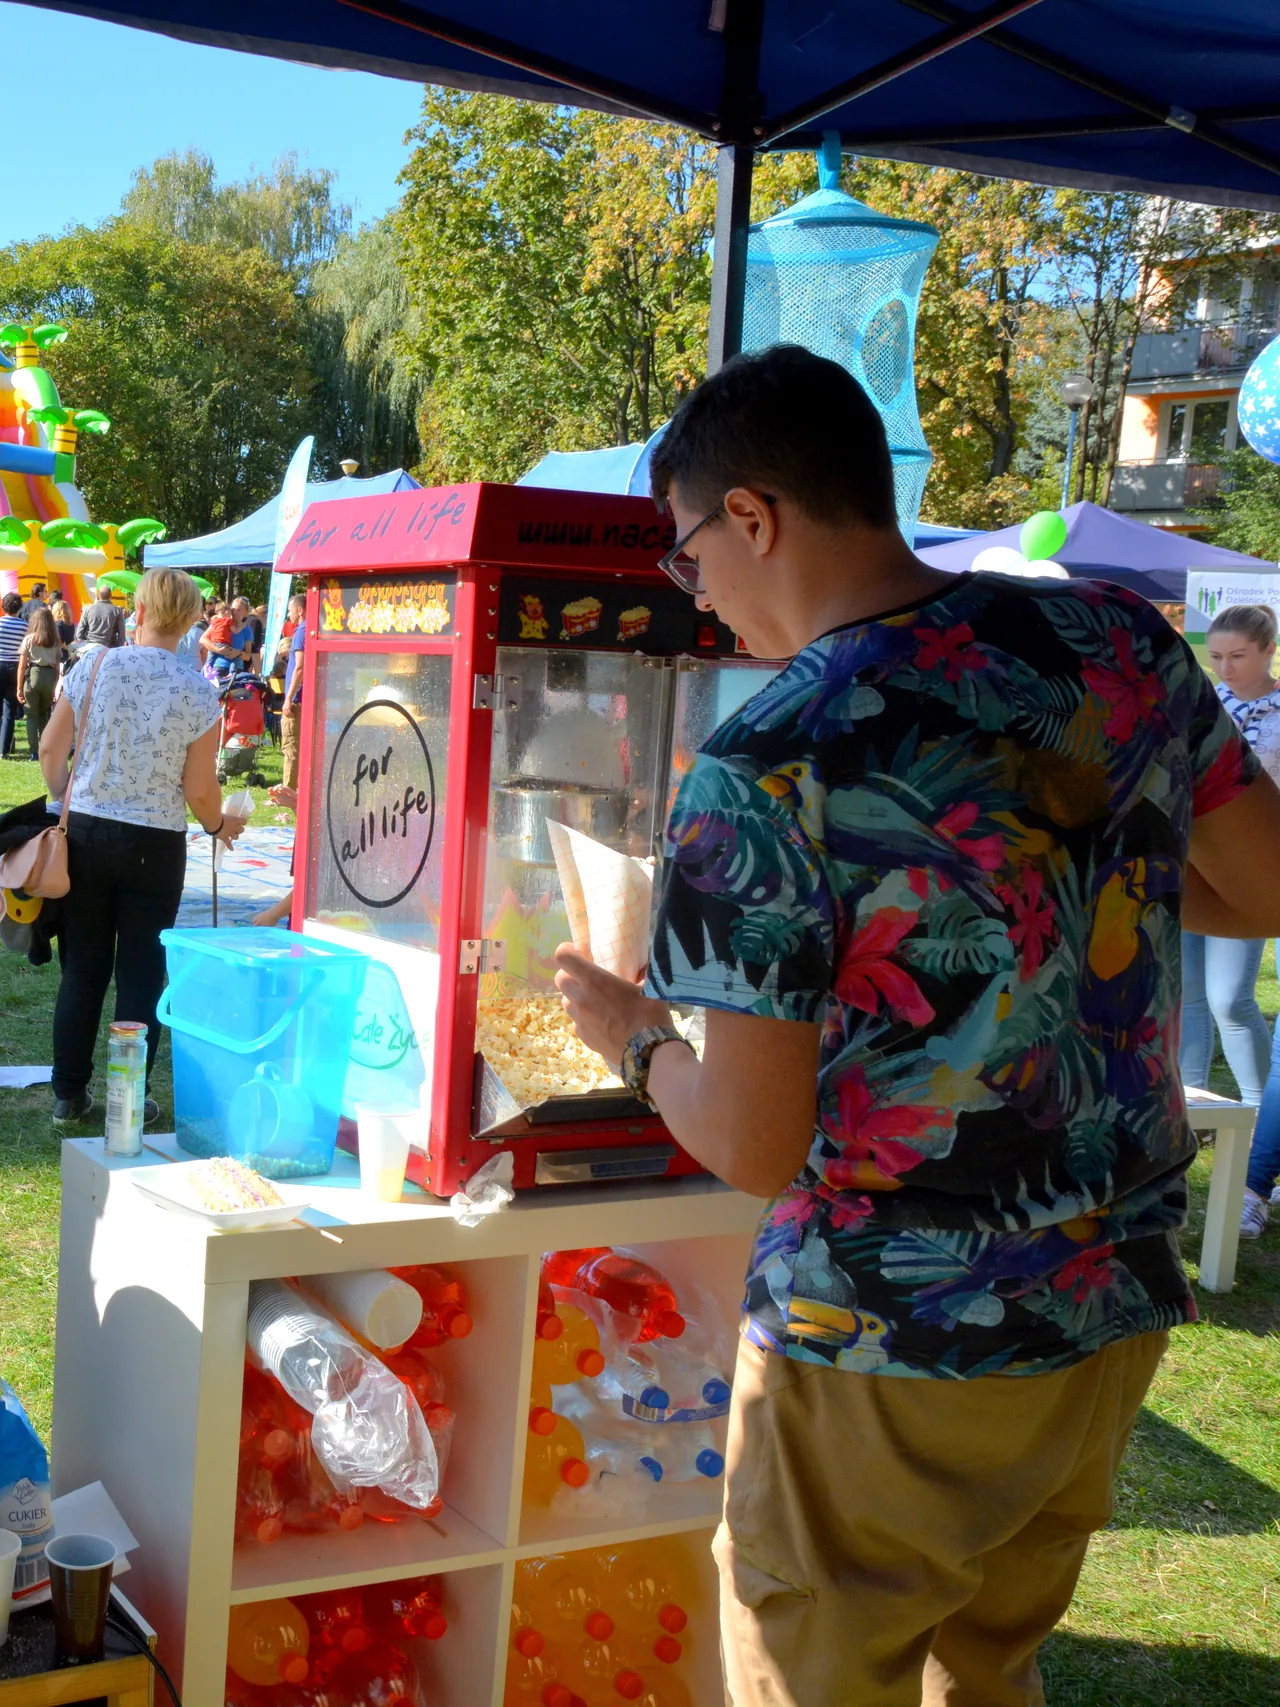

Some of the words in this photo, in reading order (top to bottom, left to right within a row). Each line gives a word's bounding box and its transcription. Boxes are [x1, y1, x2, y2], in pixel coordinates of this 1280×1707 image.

[287, 519, 338, 563] for
[350, 506, 397, 542] all
[406, 492, 467, 541] life
[352, 745, 394, 808] for
[341, 810, 375, 863] all
[381, 785, 429, 839] life
[8, 1507, 48, 1522] CUKIER
